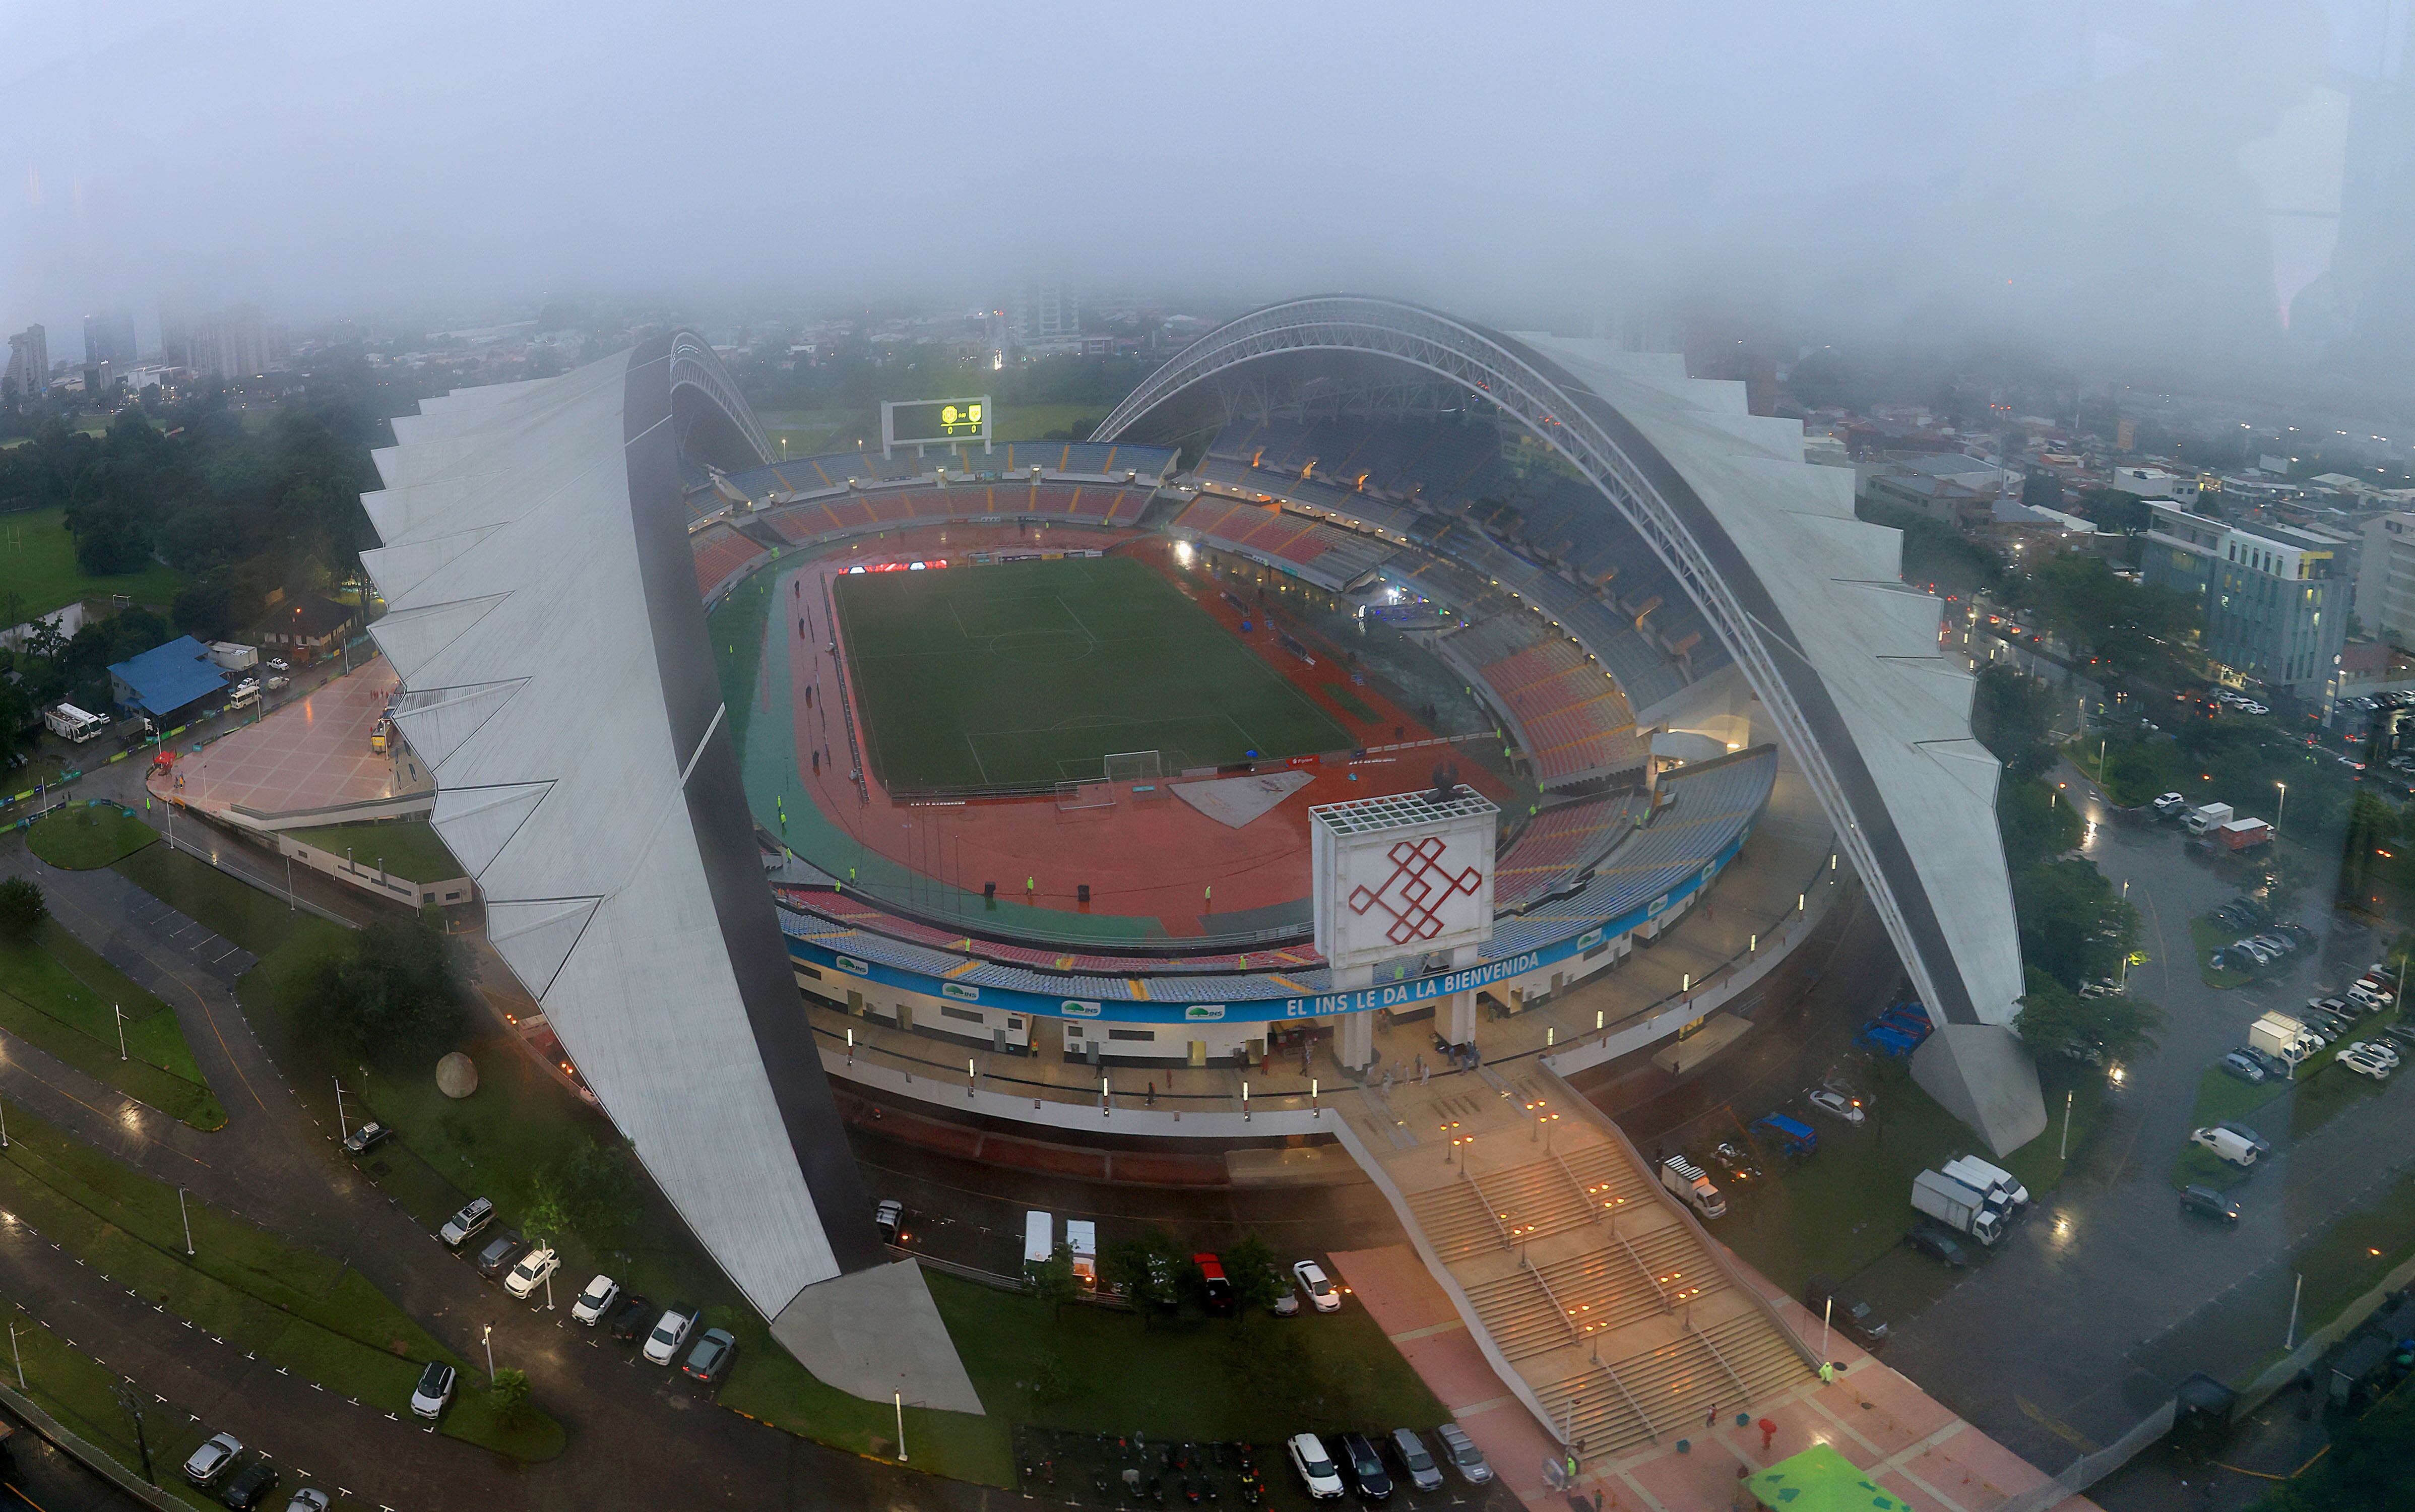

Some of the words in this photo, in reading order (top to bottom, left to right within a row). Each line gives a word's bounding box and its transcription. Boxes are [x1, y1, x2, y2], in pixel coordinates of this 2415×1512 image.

[947, 426, 953, 434] 0
[971, 425, 977, 433] 0
[1287, 999, 1307, 1016] EL
[1315, 994, 1348, 1014] INS
[1357, 990, 1375, 1009] LE
[1383, 985, 1408, 1004] DA
[1416, 980, 1436, 998] LA
[1444, 952, 1539, 992] BIENVENIDA
